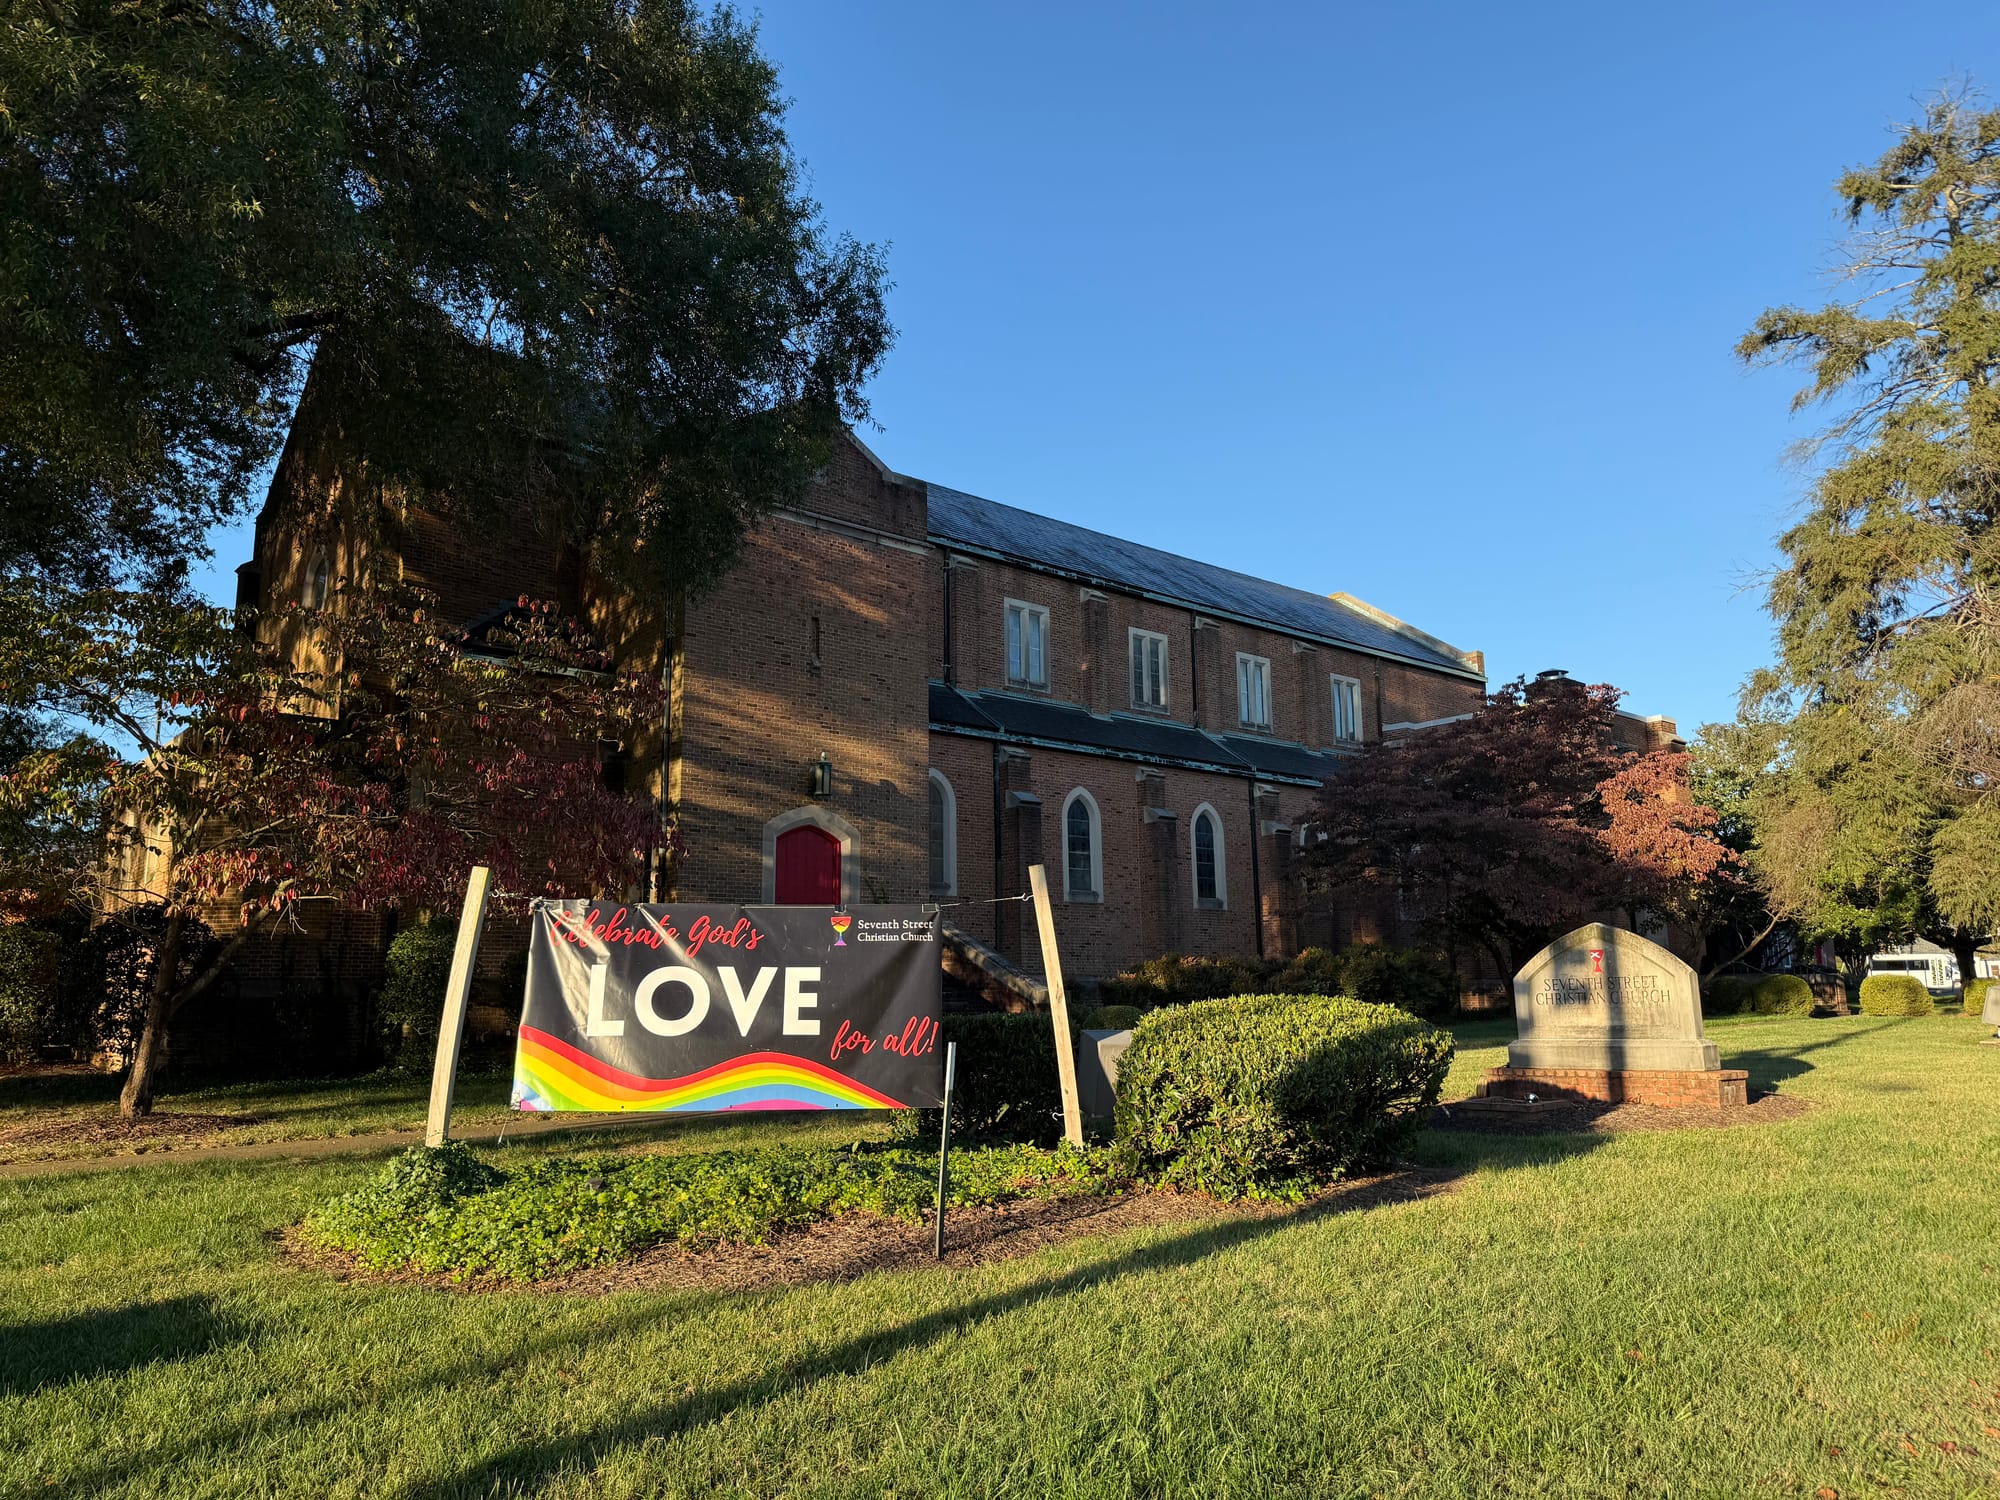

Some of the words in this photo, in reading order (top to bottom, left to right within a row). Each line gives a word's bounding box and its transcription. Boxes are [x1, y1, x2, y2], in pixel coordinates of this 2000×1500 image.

[857, 919, 900, 929] Seventh
[902, 919, 934, 929] Street
[550, 907, 680, 949] Celebrate
[685, 915, 765, 959] God's
[857, 932, 899, 942] Christian
[901, 932, 934, 942] Church
[1543, 977, 1603, 992] SEVENTH
[1607, 975, 1658, 990] STREET
[586, 964, 821, 1038] LOVE
[1535, 992, 1606, 1005] CHRISTIAN
[1609, 990, 1671, 1005] CHURCH
[830, 1019, 877, 1061] for
[883, 1015, 939, 1057] all!
